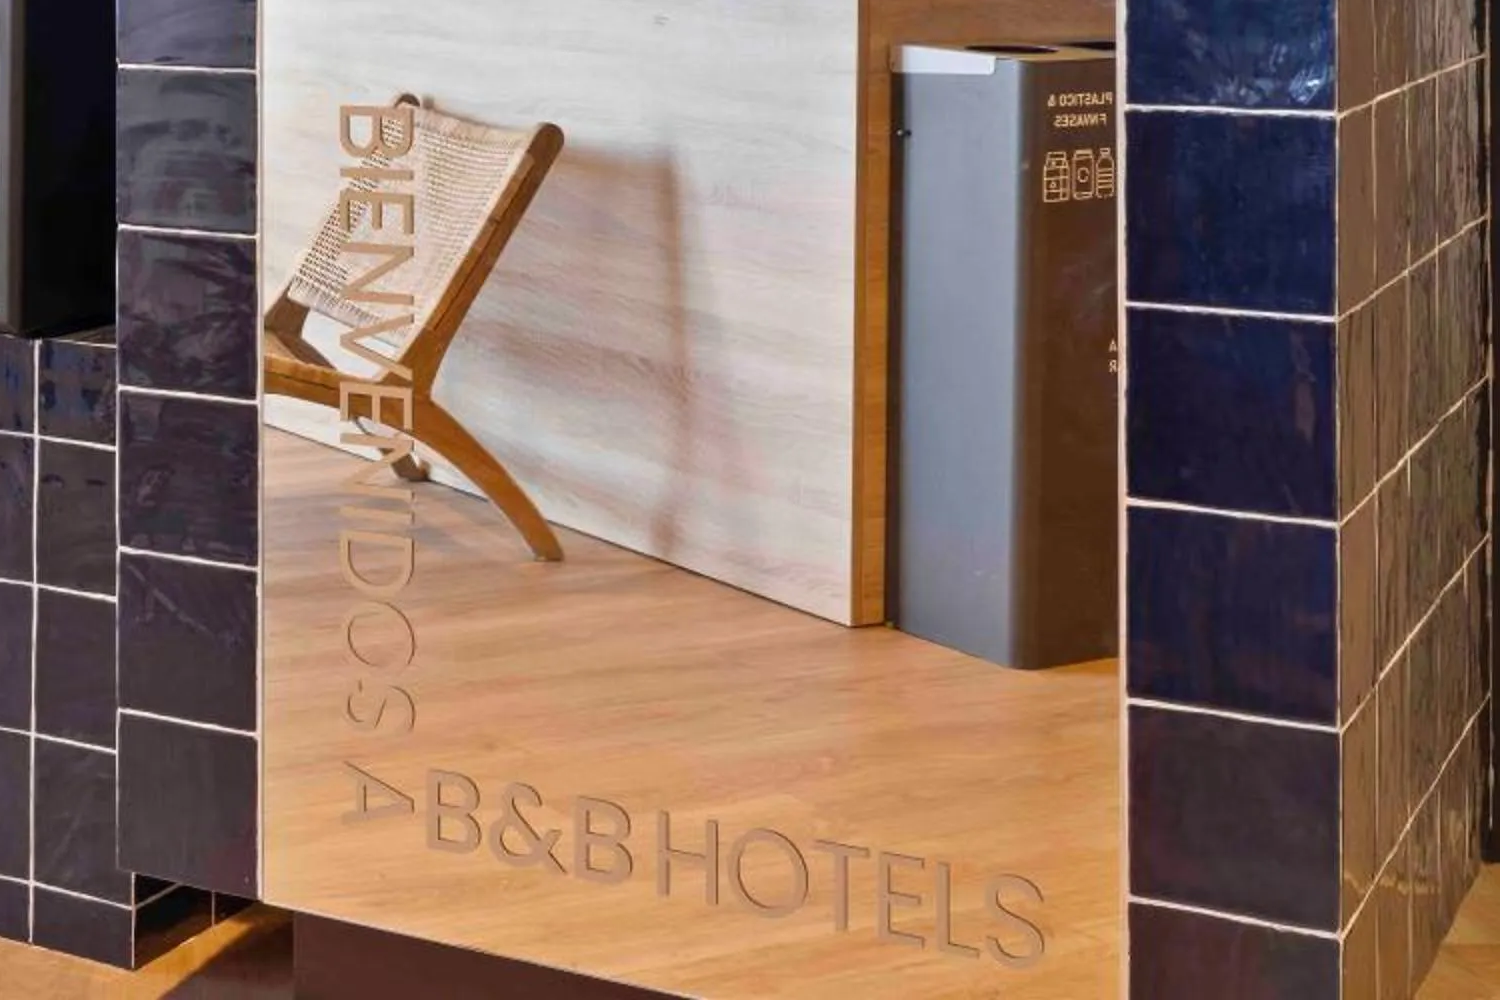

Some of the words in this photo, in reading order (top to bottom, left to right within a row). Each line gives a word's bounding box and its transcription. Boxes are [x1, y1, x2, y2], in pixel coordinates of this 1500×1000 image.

[339, 105, 416, 734] BIENVENIDOS
[341, 761, 416, 825] A
[425, 768, 635, 885] B&B
[657, 809, 1047, 969] HOTELS
